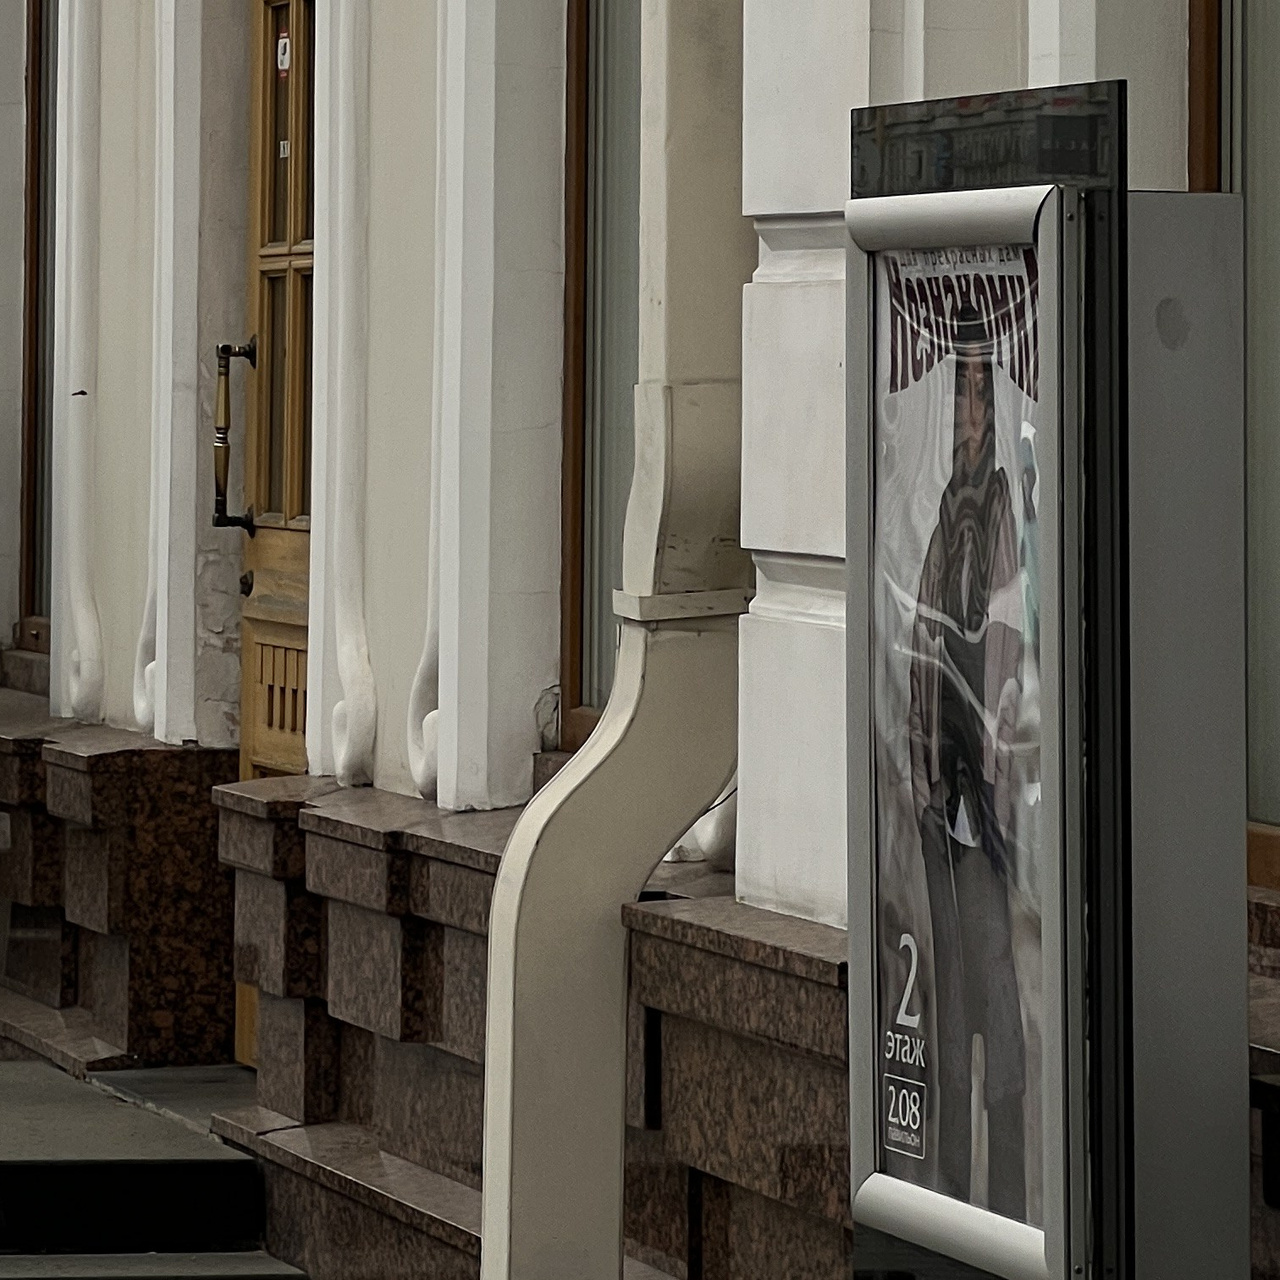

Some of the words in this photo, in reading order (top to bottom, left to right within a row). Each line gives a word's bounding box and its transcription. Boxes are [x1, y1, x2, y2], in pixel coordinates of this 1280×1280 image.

[896, 933, 920, 1028] 2
[885, 1031, 926, 1067] этаж
[888, 1085, 920, 1130] 208
